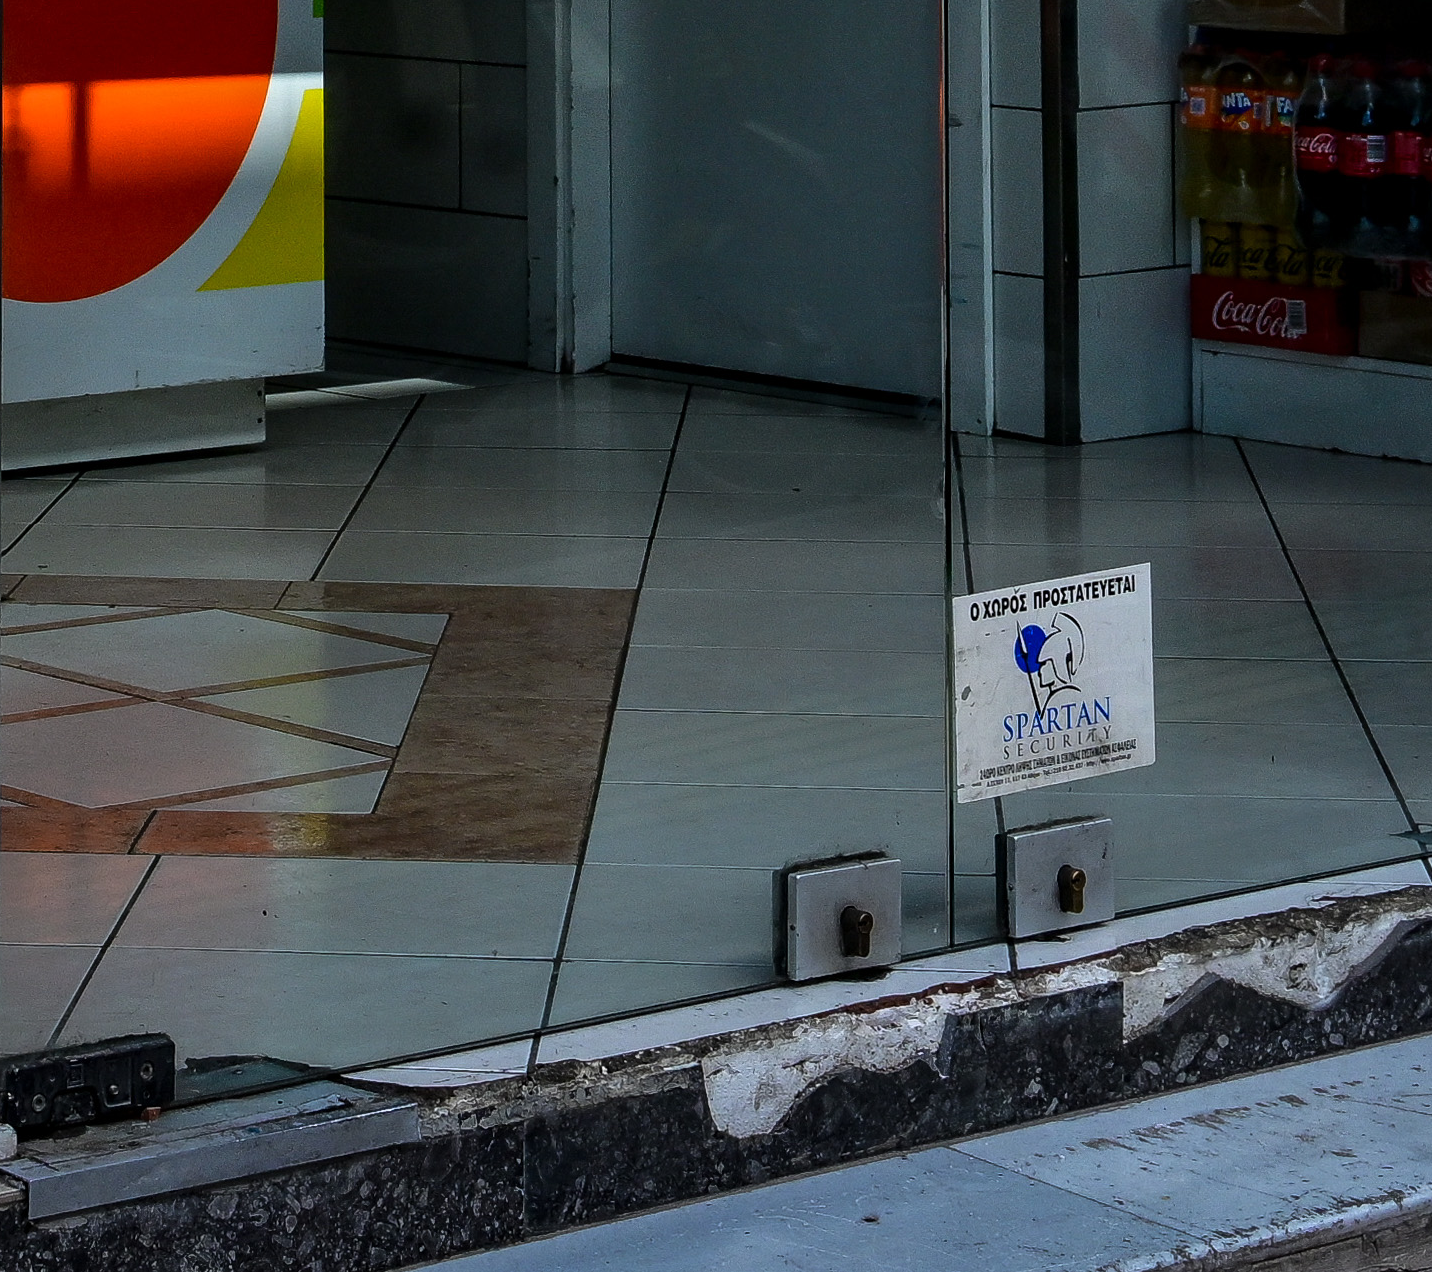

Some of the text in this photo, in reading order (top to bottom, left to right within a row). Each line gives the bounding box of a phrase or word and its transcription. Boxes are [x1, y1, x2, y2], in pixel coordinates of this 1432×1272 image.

[970, 575, 1135, 621] Ο ΧΩΡΟΣ ΠΡΟΣΤΑΤΕΥΕΤΑΙ
[1003, 696, 1110, 742] SPARTAN
[1003, 725, 1112, 760] SECURITY
